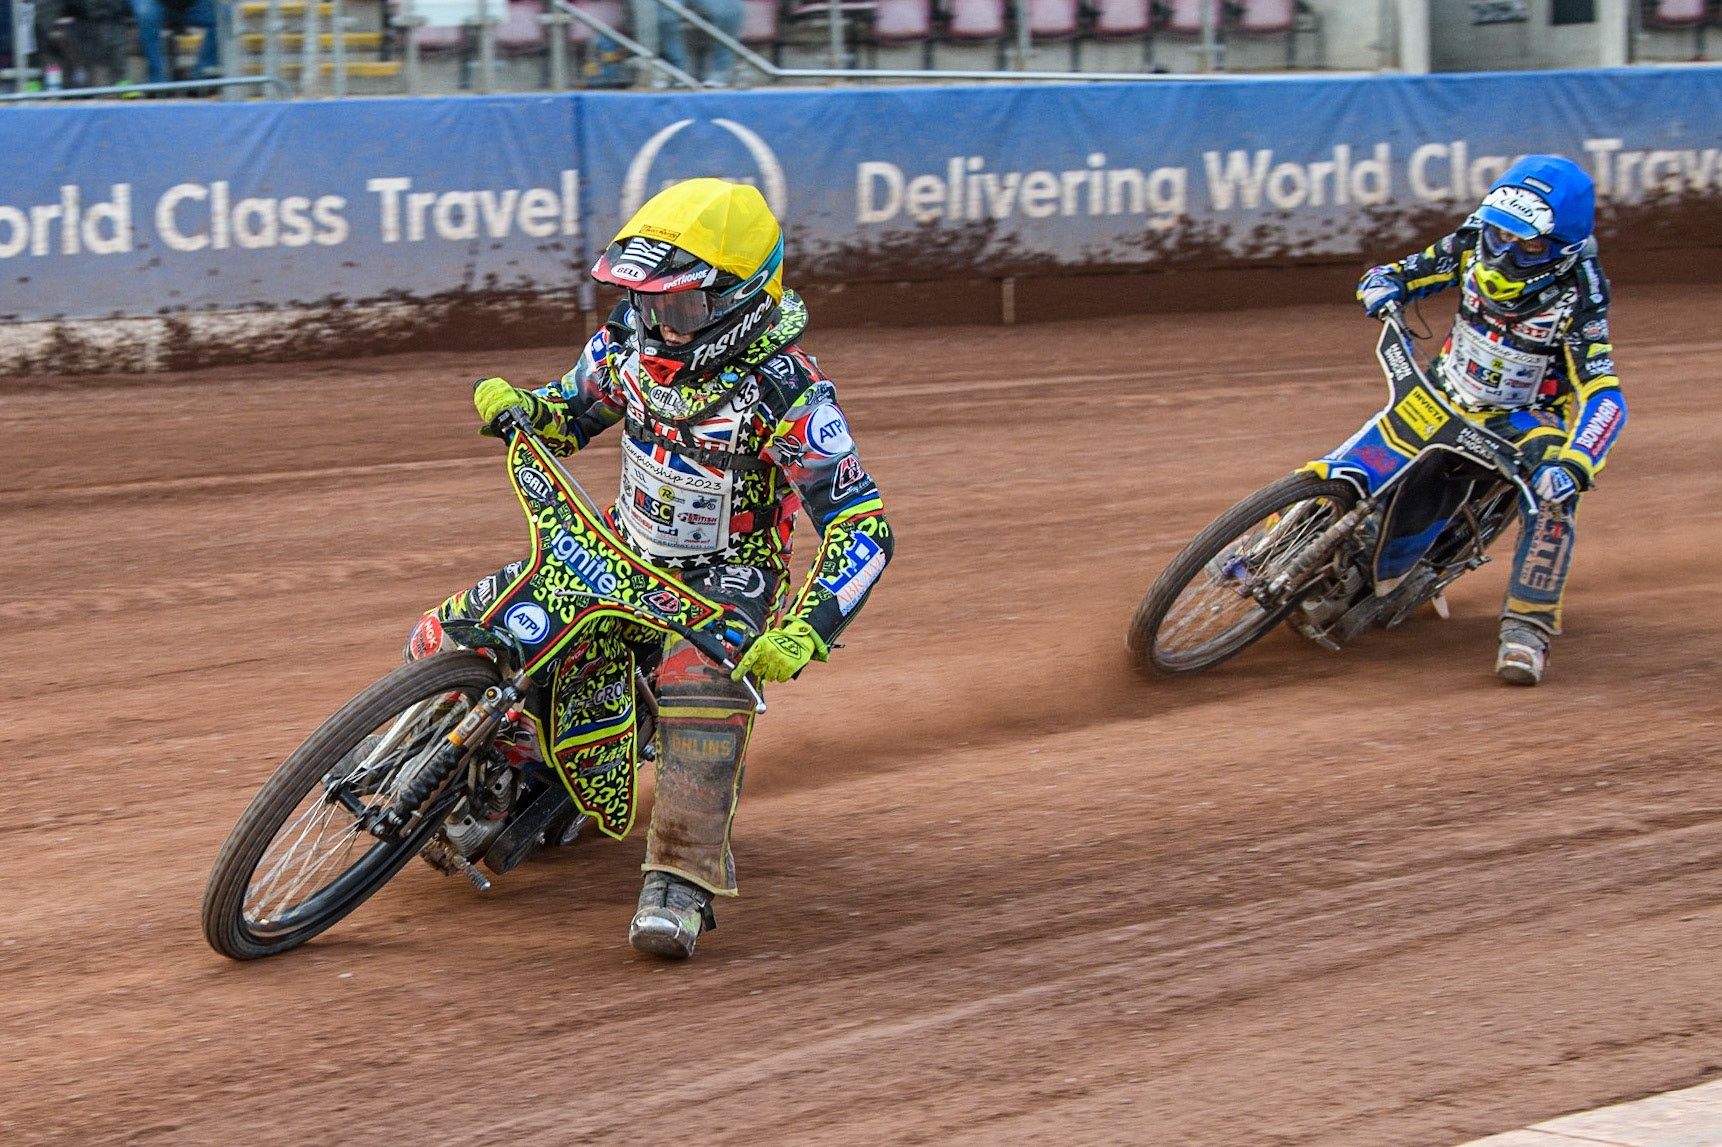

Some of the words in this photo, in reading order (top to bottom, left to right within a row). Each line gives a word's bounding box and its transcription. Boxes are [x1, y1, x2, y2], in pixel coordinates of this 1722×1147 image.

[857, 152, 1188, 229] Delivering
[1203, 142, 1392, 210] World
[1408, 140, 1527, 201] Cla
[1582, 138, 1722, 198] Trav
[0, 182, 132, 258] orld
[154, 181, 350, 251] Class
[366, 169, 581, 242] Travel
[616, 267, 639, 278] BELL
[663, 269, 709, 291] FASTHOUSE
[1576, 398, 1620, 449] BOWMAN
[523, 472, 549, 498] BALL
[685, 477, 722, 491] 2023
[635, 488, 671, 520] NSSC
[424, 619, 438, 649] NGK
[513, 612, 540, 637] ATPI
